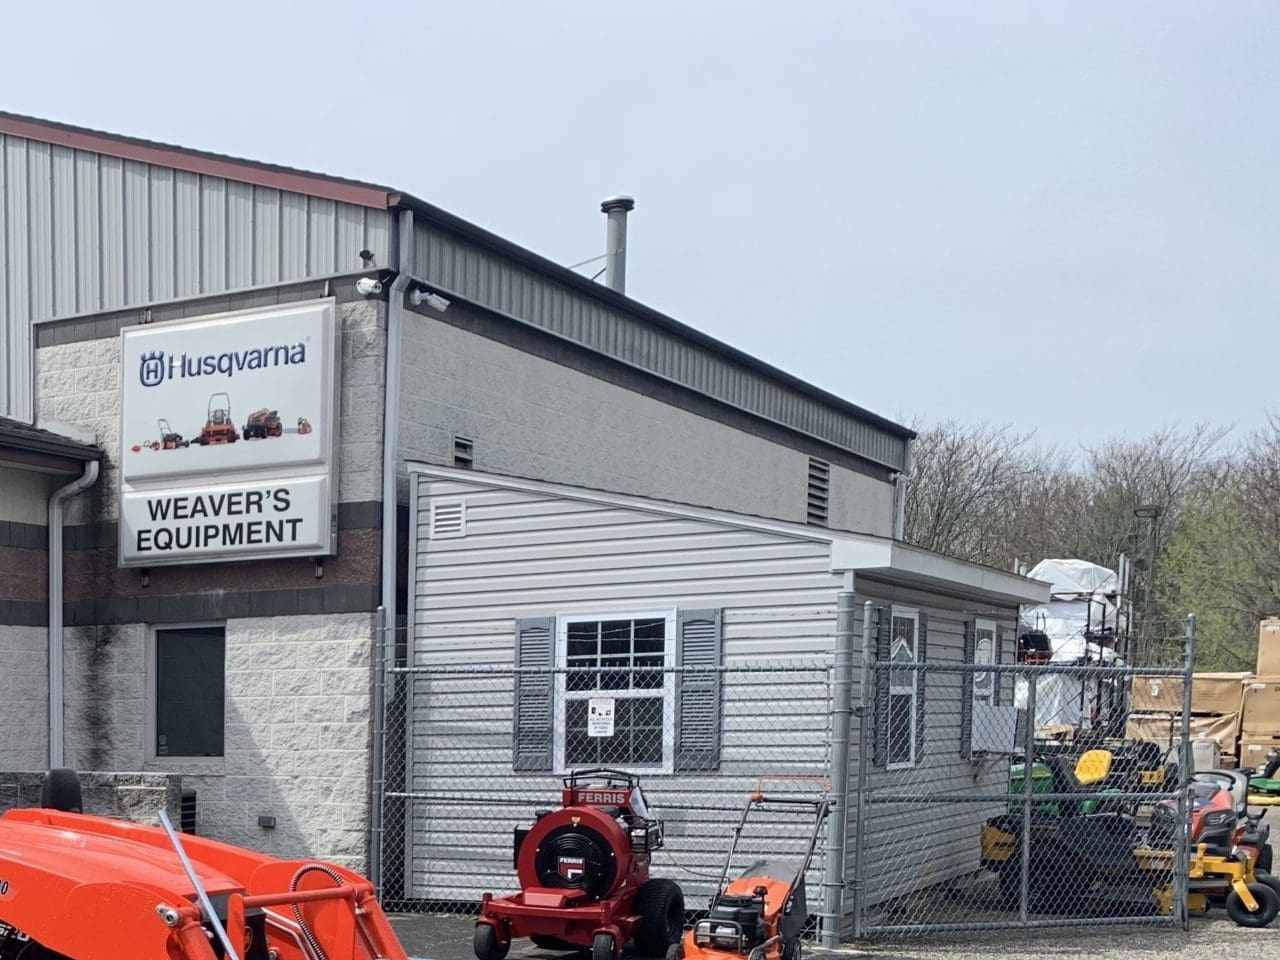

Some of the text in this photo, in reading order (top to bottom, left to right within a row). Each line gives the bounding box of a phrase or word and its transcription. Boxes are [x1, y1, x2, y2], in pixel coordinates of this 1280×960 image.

[168, 342, 306, 379] Husqvarna
[147, 488, 291, 521] WEAVER'S
[136, 518, 303, 552] EQUIPMENT
[577, 792, 625, 804] FERRIS
